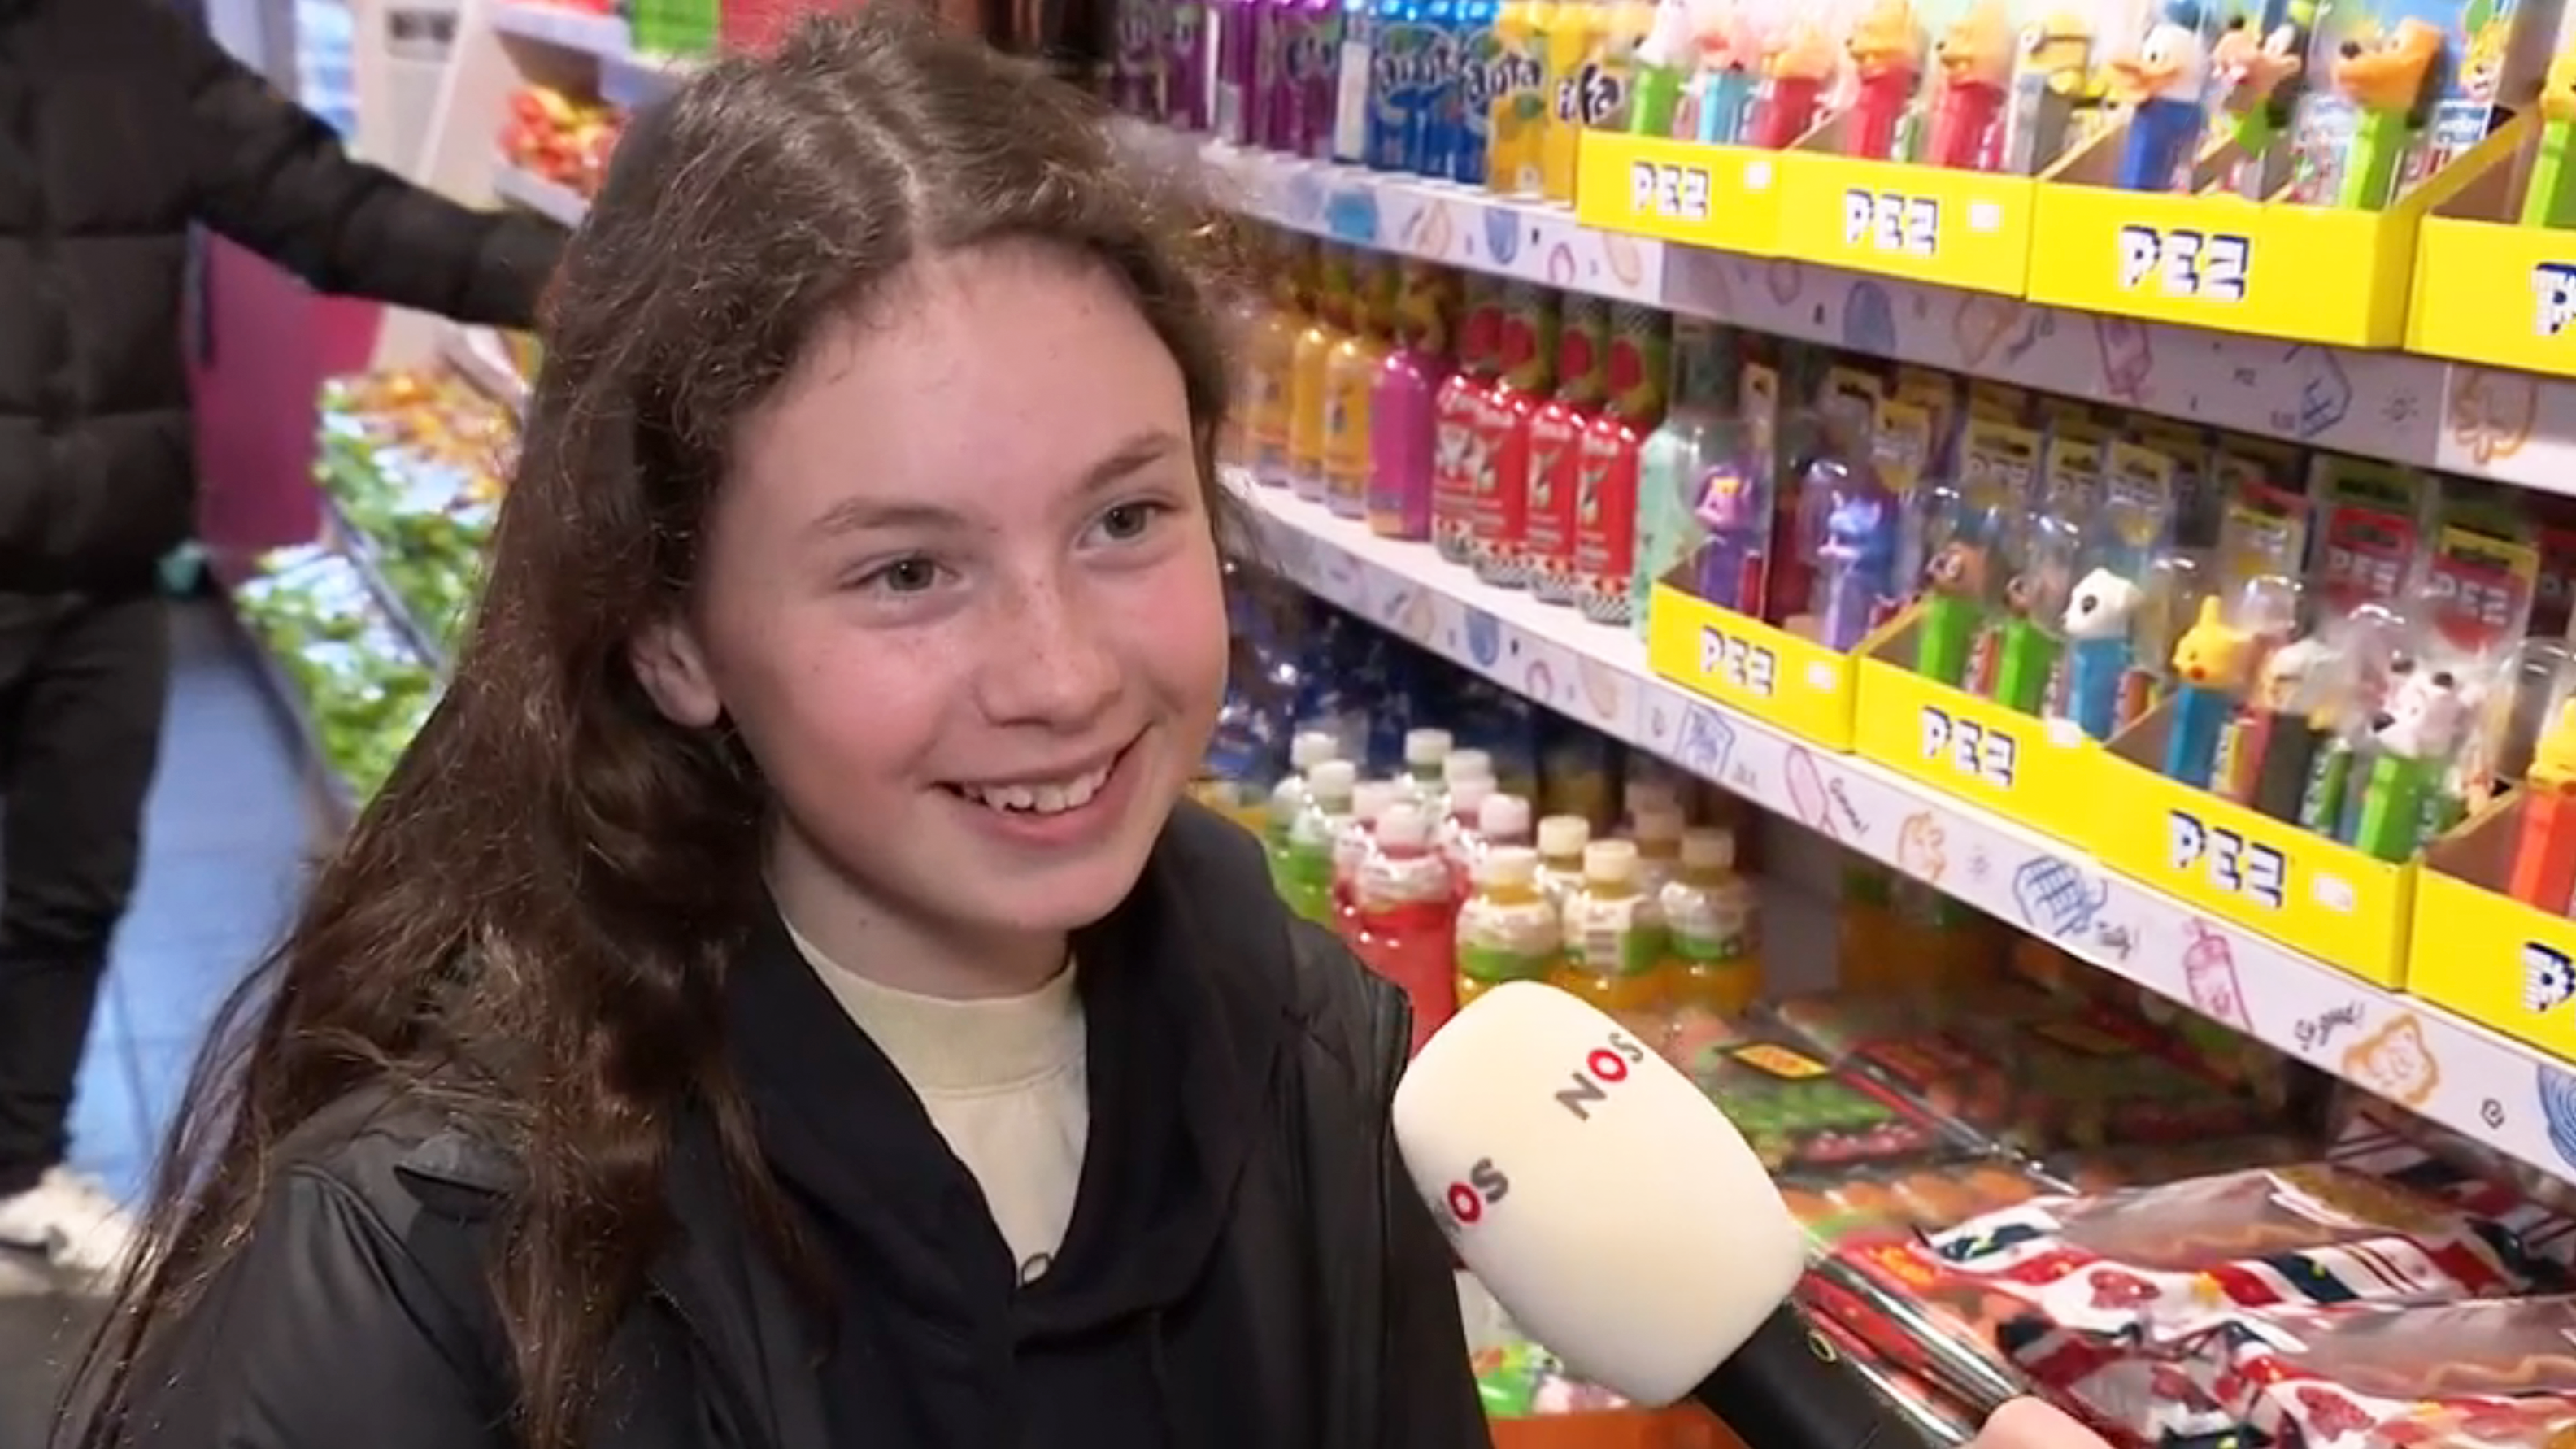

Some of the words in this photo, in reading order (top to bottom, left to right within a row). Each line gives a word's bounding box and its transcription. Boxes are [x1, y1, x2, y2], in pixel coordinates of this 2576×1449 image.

[1633, 162, 1709, 220] PEZ
[1844, 189, 1940, 255] PEZ
[2121, 224, 2250, 301] PEZ
[2328, 547, 2400, 599] PEZ
[2430, 572, 2509, 628] PEZ
[1699, 624, 1776, 698] PEZ
[1921, 704, 2017, 788] PEZ
[2169, 808, 2287, 909] PEZ
[1553, 1031, 1645, 1121] NOS
